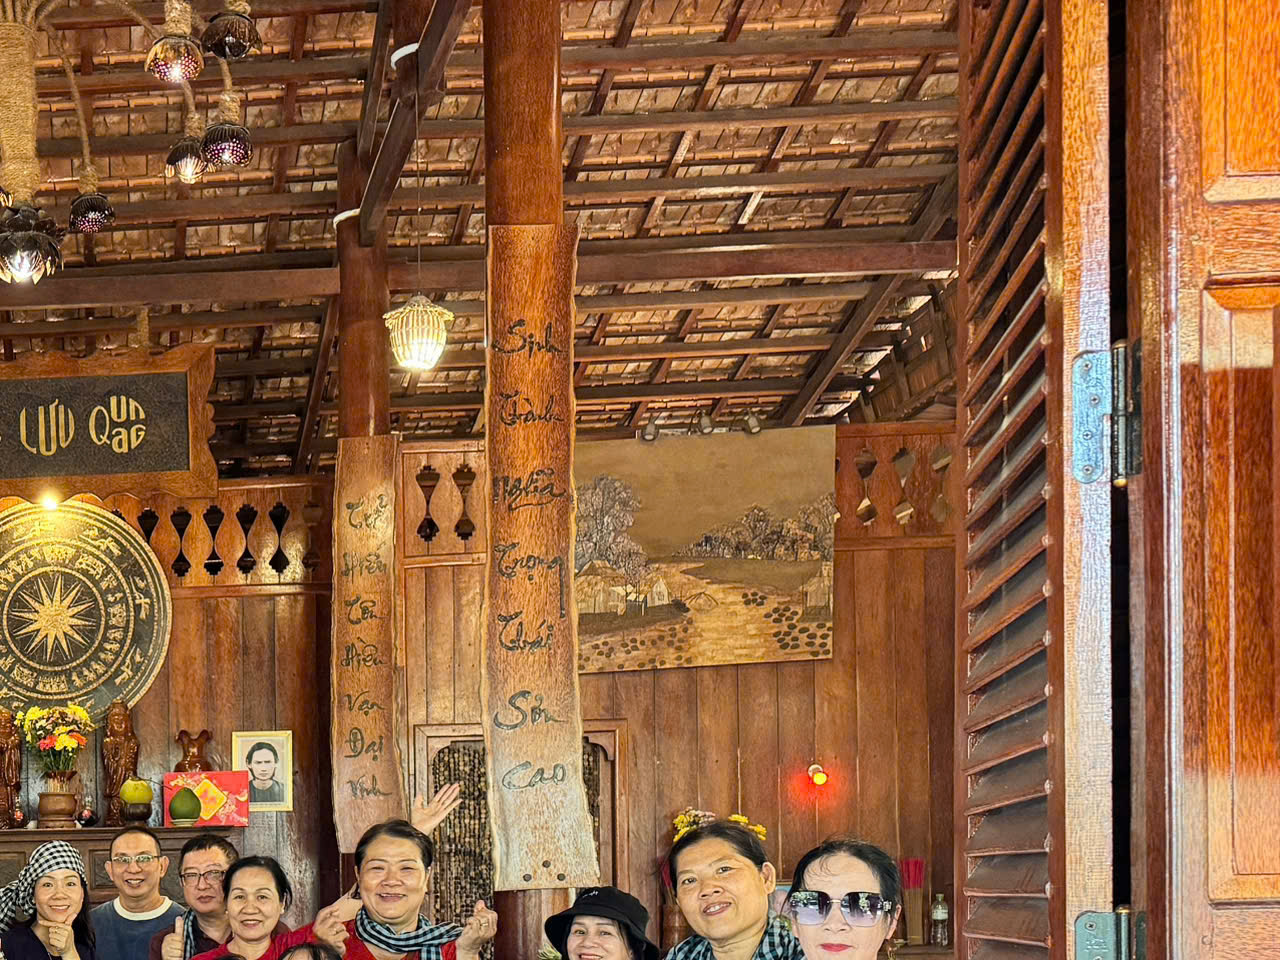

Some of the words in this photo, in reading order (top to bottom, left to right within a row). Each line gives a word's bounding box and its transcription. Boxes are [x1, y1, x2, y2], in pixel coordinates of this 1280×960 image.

[493, 319, 563, 359] Sinh
[498, 611, 554, 651] Thái
[344, 690, 385, 717] Vạn
[344, 727, 383, 761] Đại
[502, 760, 566, 790] Cao
